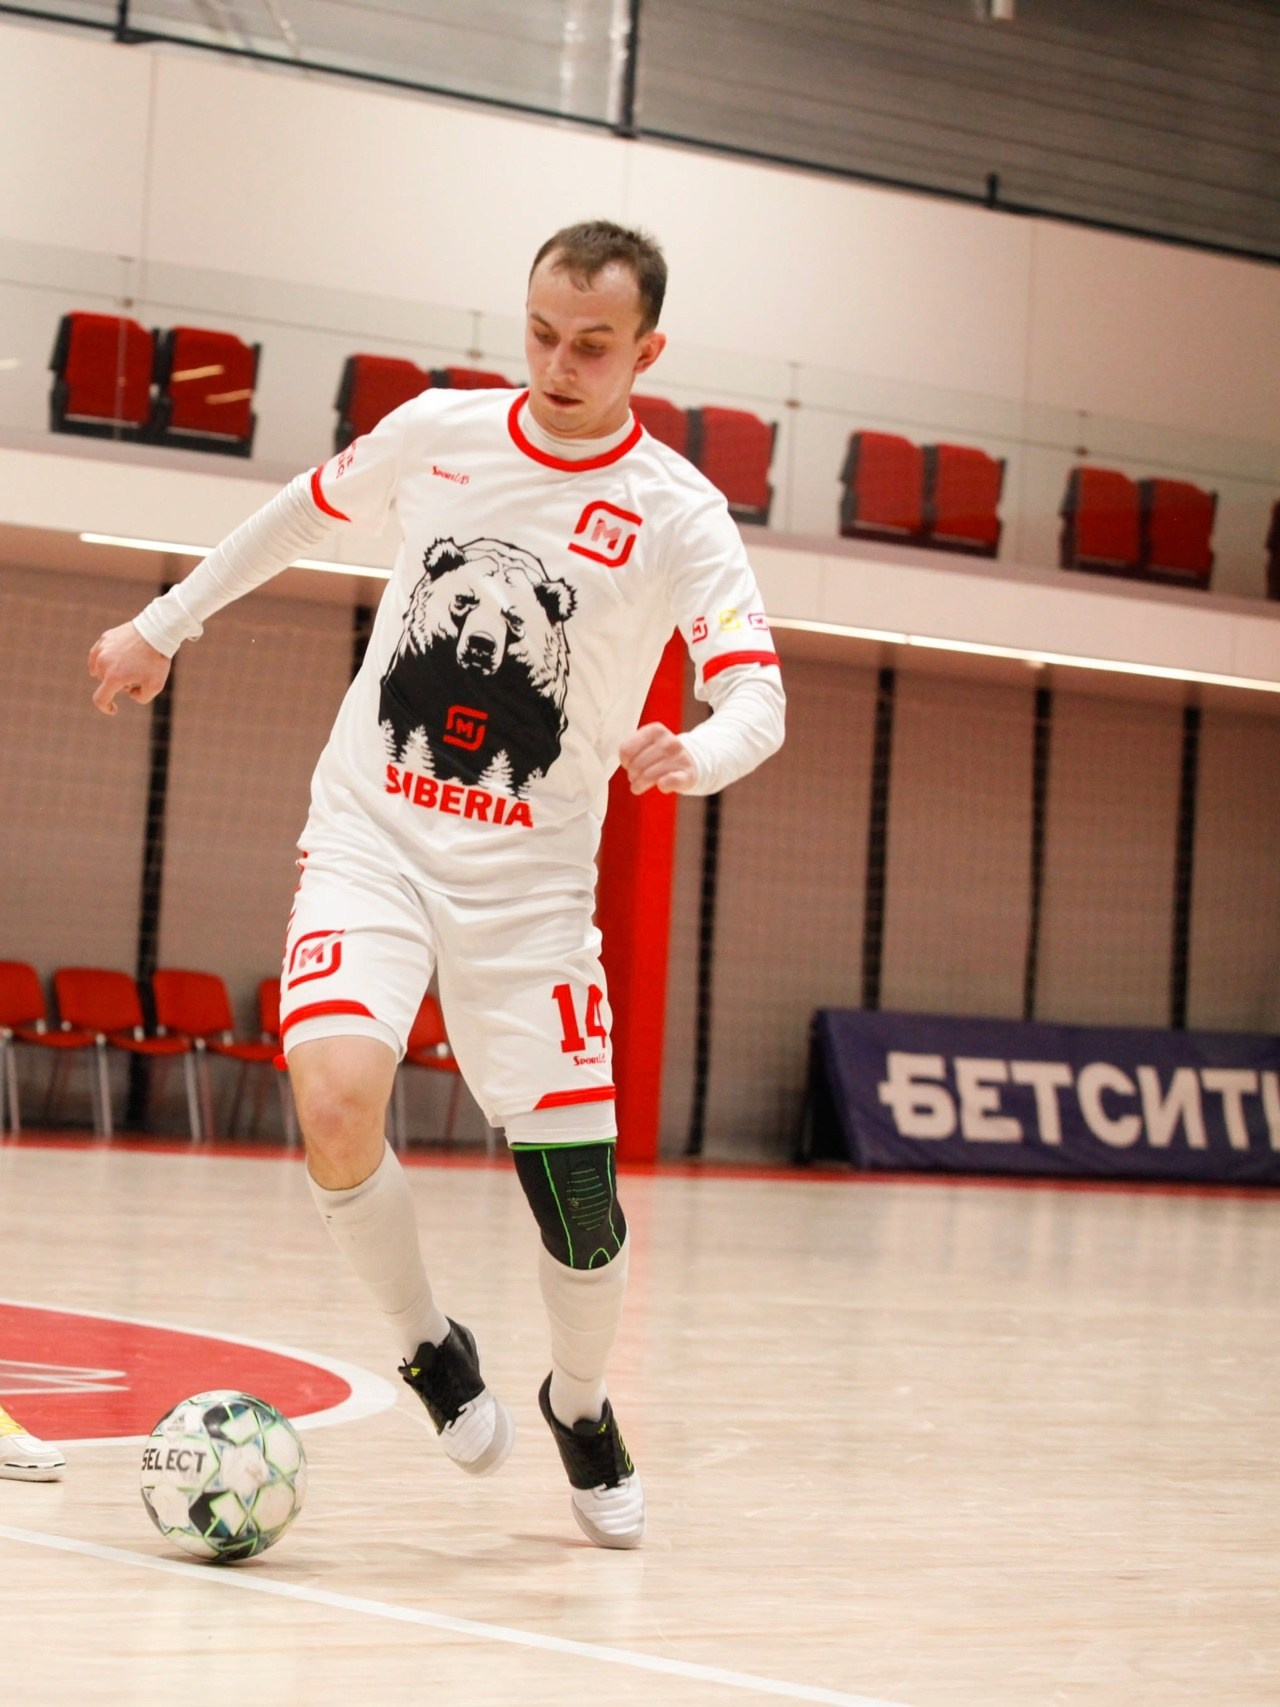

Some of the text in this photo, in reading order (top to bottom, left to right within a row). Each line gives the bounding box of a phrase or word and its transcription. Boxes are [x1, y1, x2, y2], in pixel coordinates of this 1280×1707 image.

[384, 763, 534, 828] SIBERIA
[552, 983, 608, 1053] 14
[877, 1051, 1280, 1151] БЕТСИТ
[141, 1448, 207, 1473] SELECT
